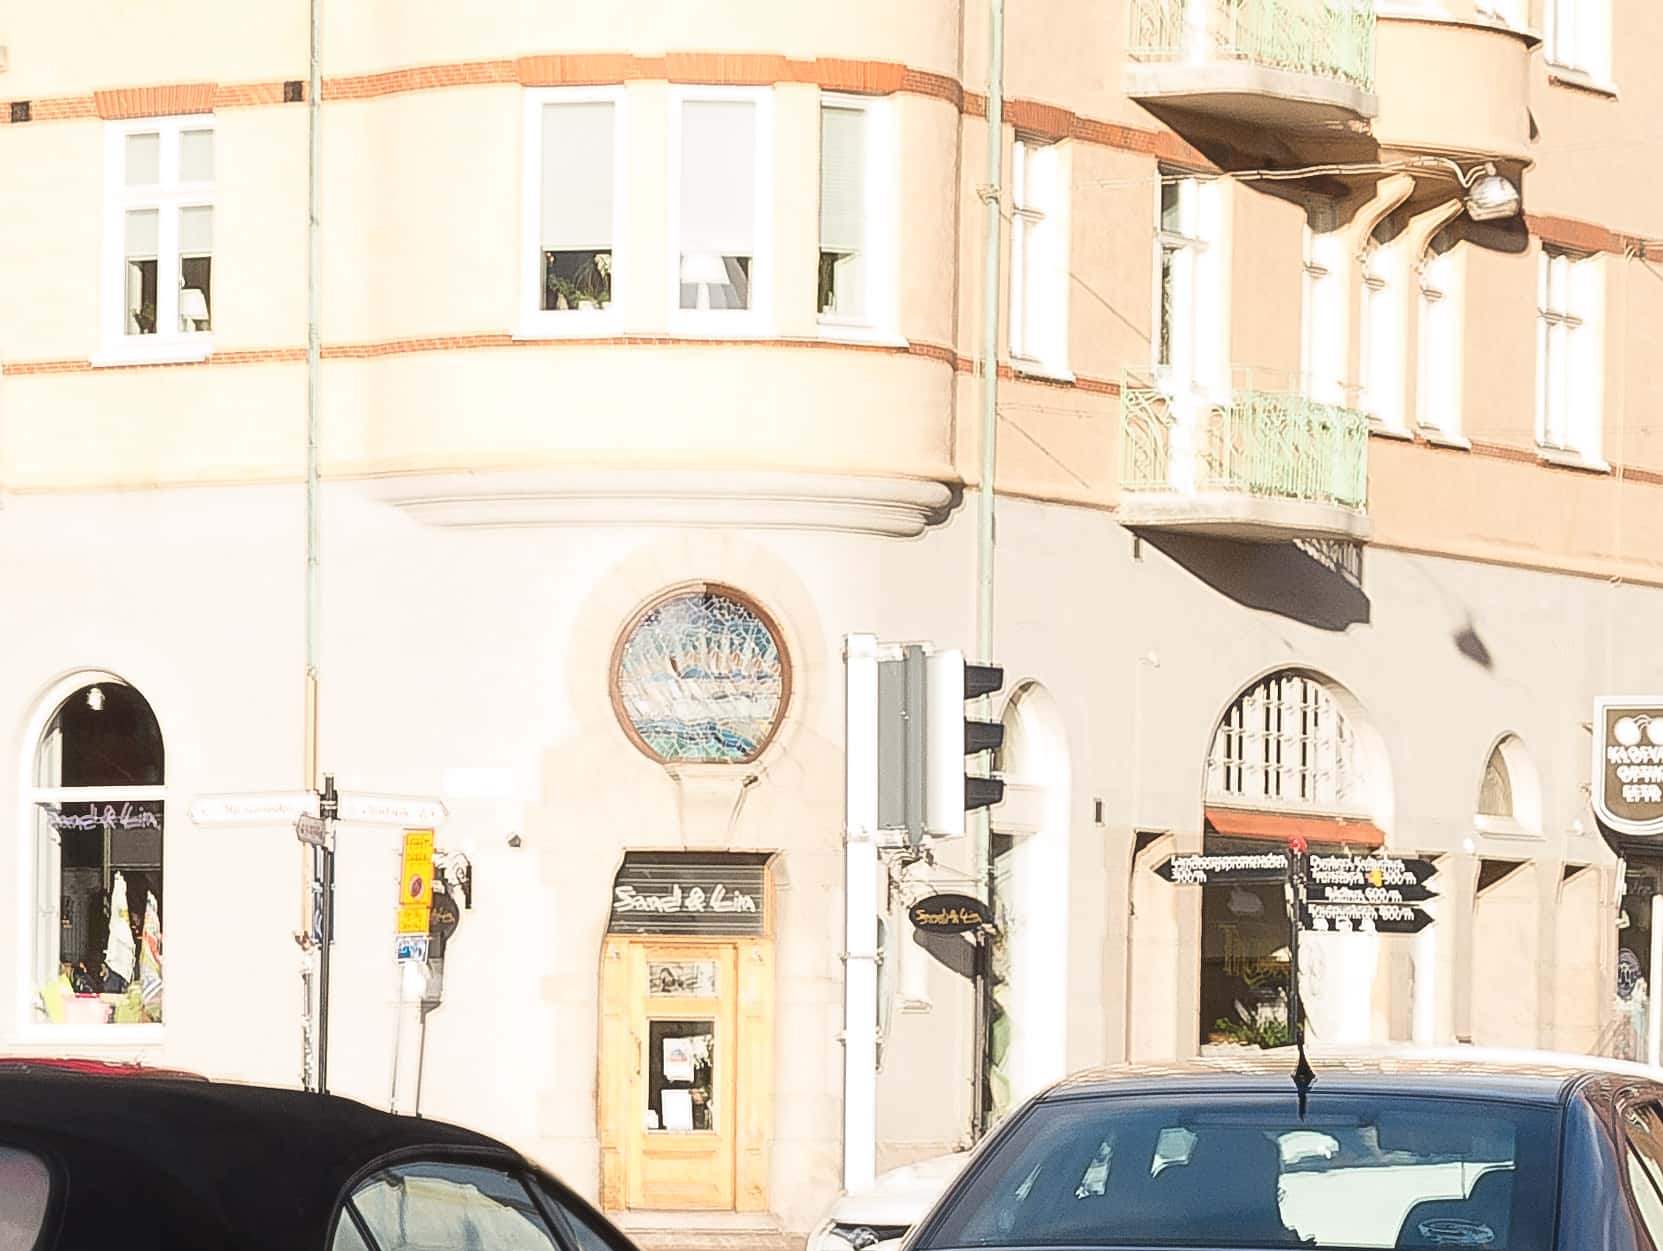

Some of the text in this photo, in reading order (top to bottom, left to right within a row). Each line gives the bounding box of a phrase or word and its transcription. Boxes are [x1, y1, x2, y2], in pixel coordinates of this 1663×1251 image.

[614, 884, 756, 912] Sand & Lin
